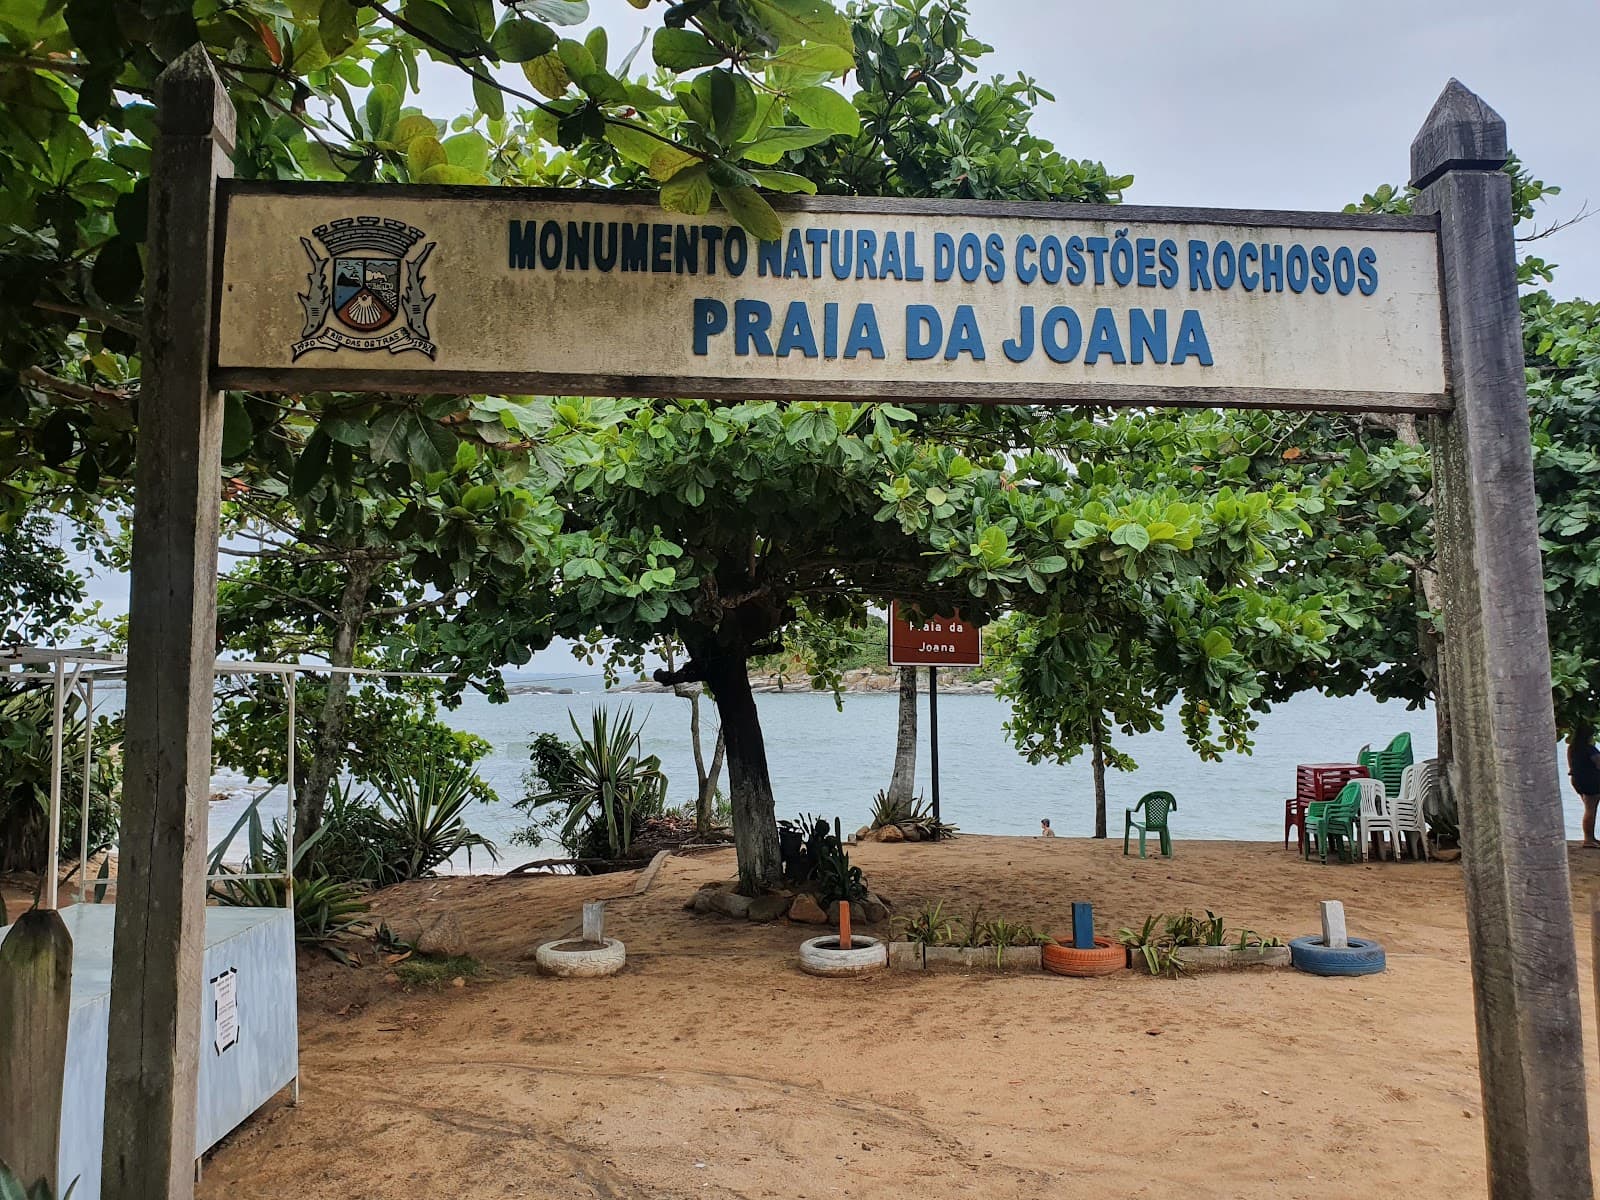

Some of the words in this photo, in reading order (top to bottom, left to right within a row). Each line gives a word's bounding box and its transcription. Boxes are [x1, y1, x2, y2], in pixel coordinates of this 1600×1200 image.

[508, 219, 748, 277] MONUMENTO
[757, 227, 924, 281] NATURAL
[934, 232, 1005, 284] DOS
[1015, 228, 1179, 289] COSTÕES
[1188, 239, 1378, 296] ROCHOSOS
[692, 298, 885, 360] PRAIA
[905, 304, 985, 361] DA
[1002, 305, 1214, 366] JOANA
[918, 641, 955, 653] Joana
[949, 622, 963, 633] da
